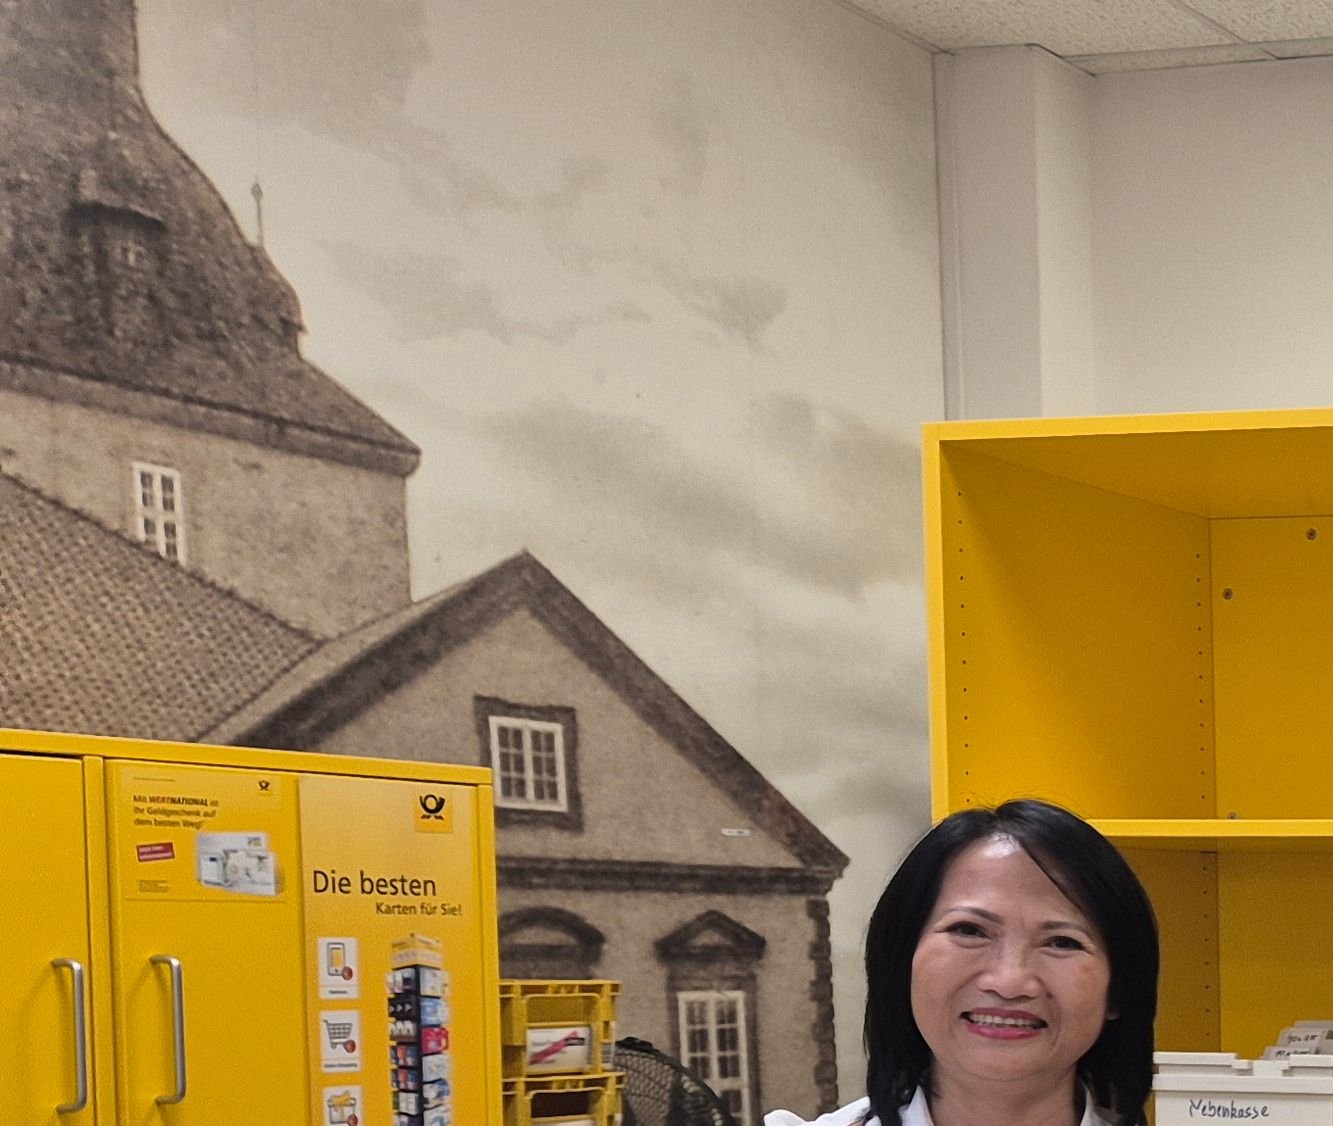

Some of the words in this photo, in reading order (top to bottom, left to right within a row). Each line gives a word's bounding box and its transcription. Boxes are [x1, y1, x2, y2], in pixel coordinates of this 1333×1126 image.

[313, 869, 351, 894] Die
[360, 869, 437, 896] besten
[375, 902, 417, 916] Karten
[420, 901, 437, 916] für
[440, 903, 462, 916] Sie!
[1189, 1099, 1270, 1120] Nebenkasse
